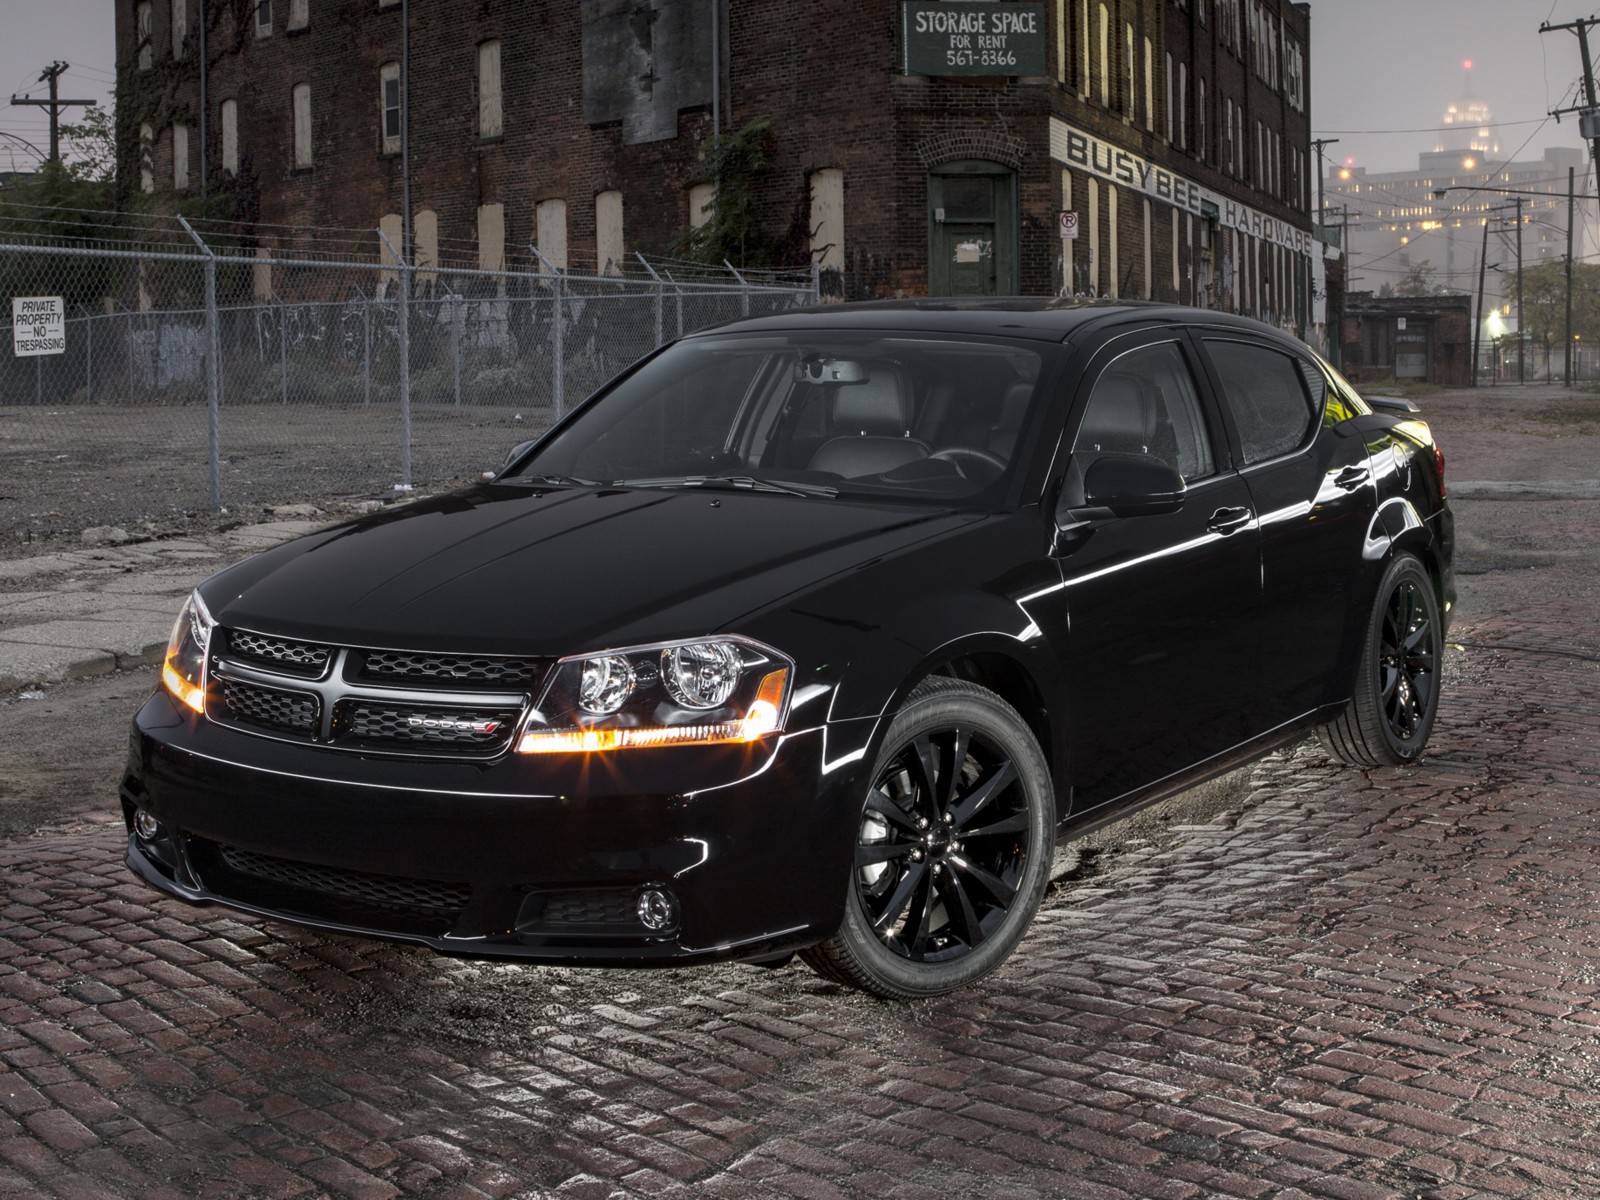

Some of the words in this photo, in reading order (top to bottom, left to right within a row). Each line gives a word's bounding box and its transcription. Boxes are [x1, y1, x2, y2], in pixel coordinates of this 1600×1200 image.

[916, 11, 986, 33] STORAGE
[992, 12, 1037, 33] SPACE
[950, 35, 971, 48] FOR
[978, 35, 1007, 48] RENT
[947, 50, 1017, 65] 567-8366
[1226, 200, 1312, 254] HARDWARE
[21, 300, 56, 313] PRIVATE
[16, 312, 62, 326] PROPERTY
[33, 326, 47, 338] NO
[16, 337, 65, 352] TRESPASSING
[407, 717, 486, 731] DODGE
